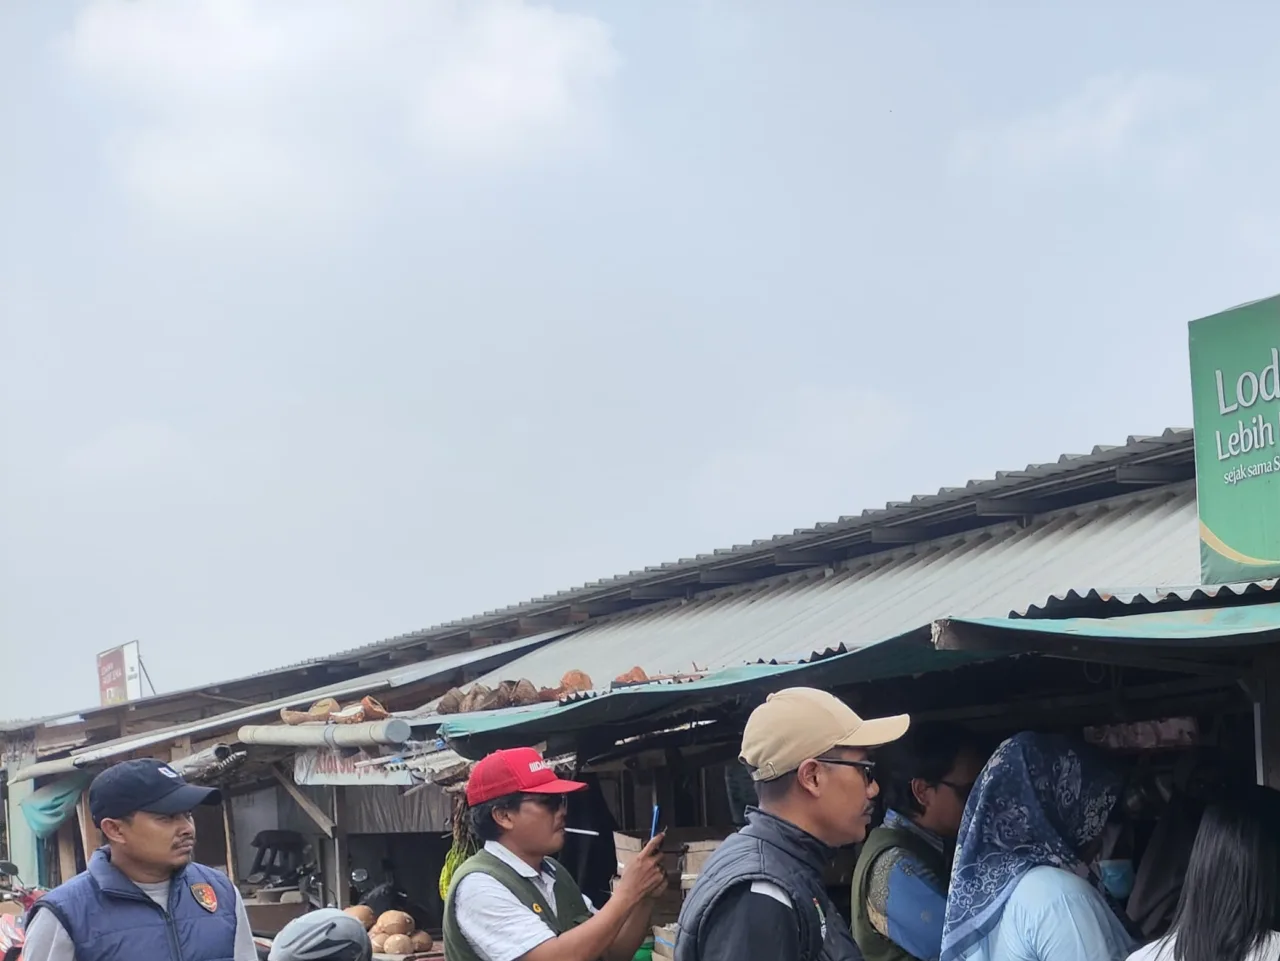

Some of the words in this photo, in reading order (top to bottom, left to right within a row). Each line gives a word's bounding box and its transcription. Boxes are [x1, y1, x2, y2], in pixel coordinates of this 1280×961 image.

[1215, 414, 1275, 461] Lebih
[1223, 464, 1250, 485] sejak
[1247, 462, 1273, 478] sama
